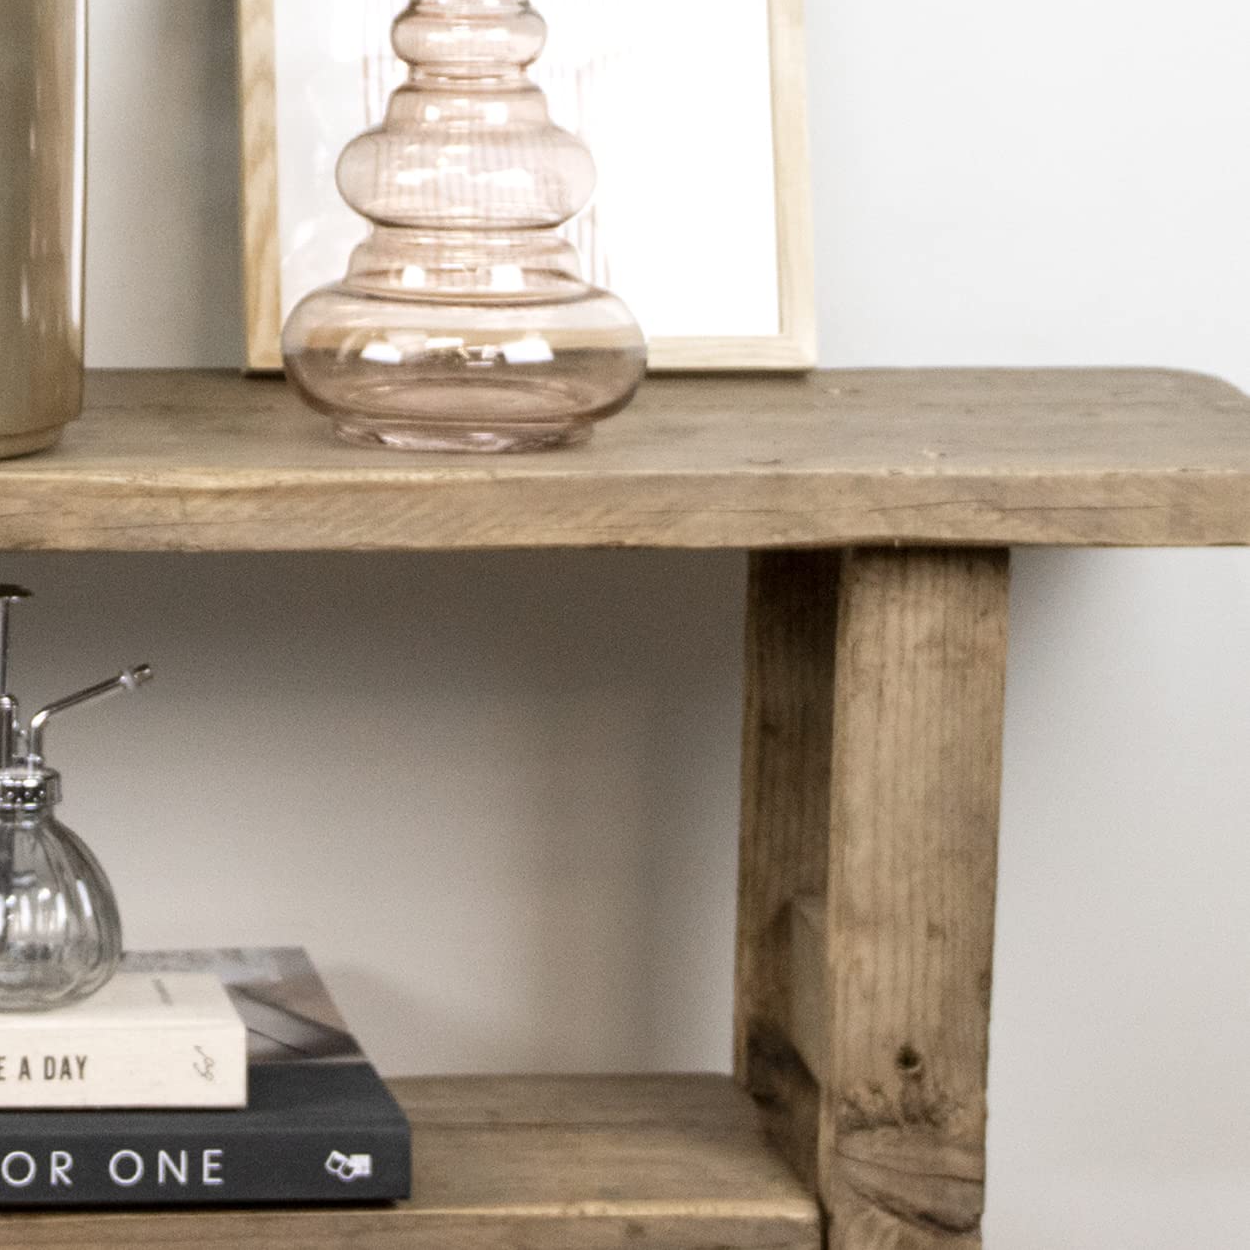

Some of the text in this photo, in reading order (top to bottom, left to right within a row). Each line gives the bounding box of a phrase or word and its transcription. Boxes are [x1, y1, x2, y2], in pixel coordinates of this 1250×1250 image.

[18, 1056, 32, 1081] A
[44, 1056, 88, 1081] DAY
[108, 1149, 224, 1187] ONE
